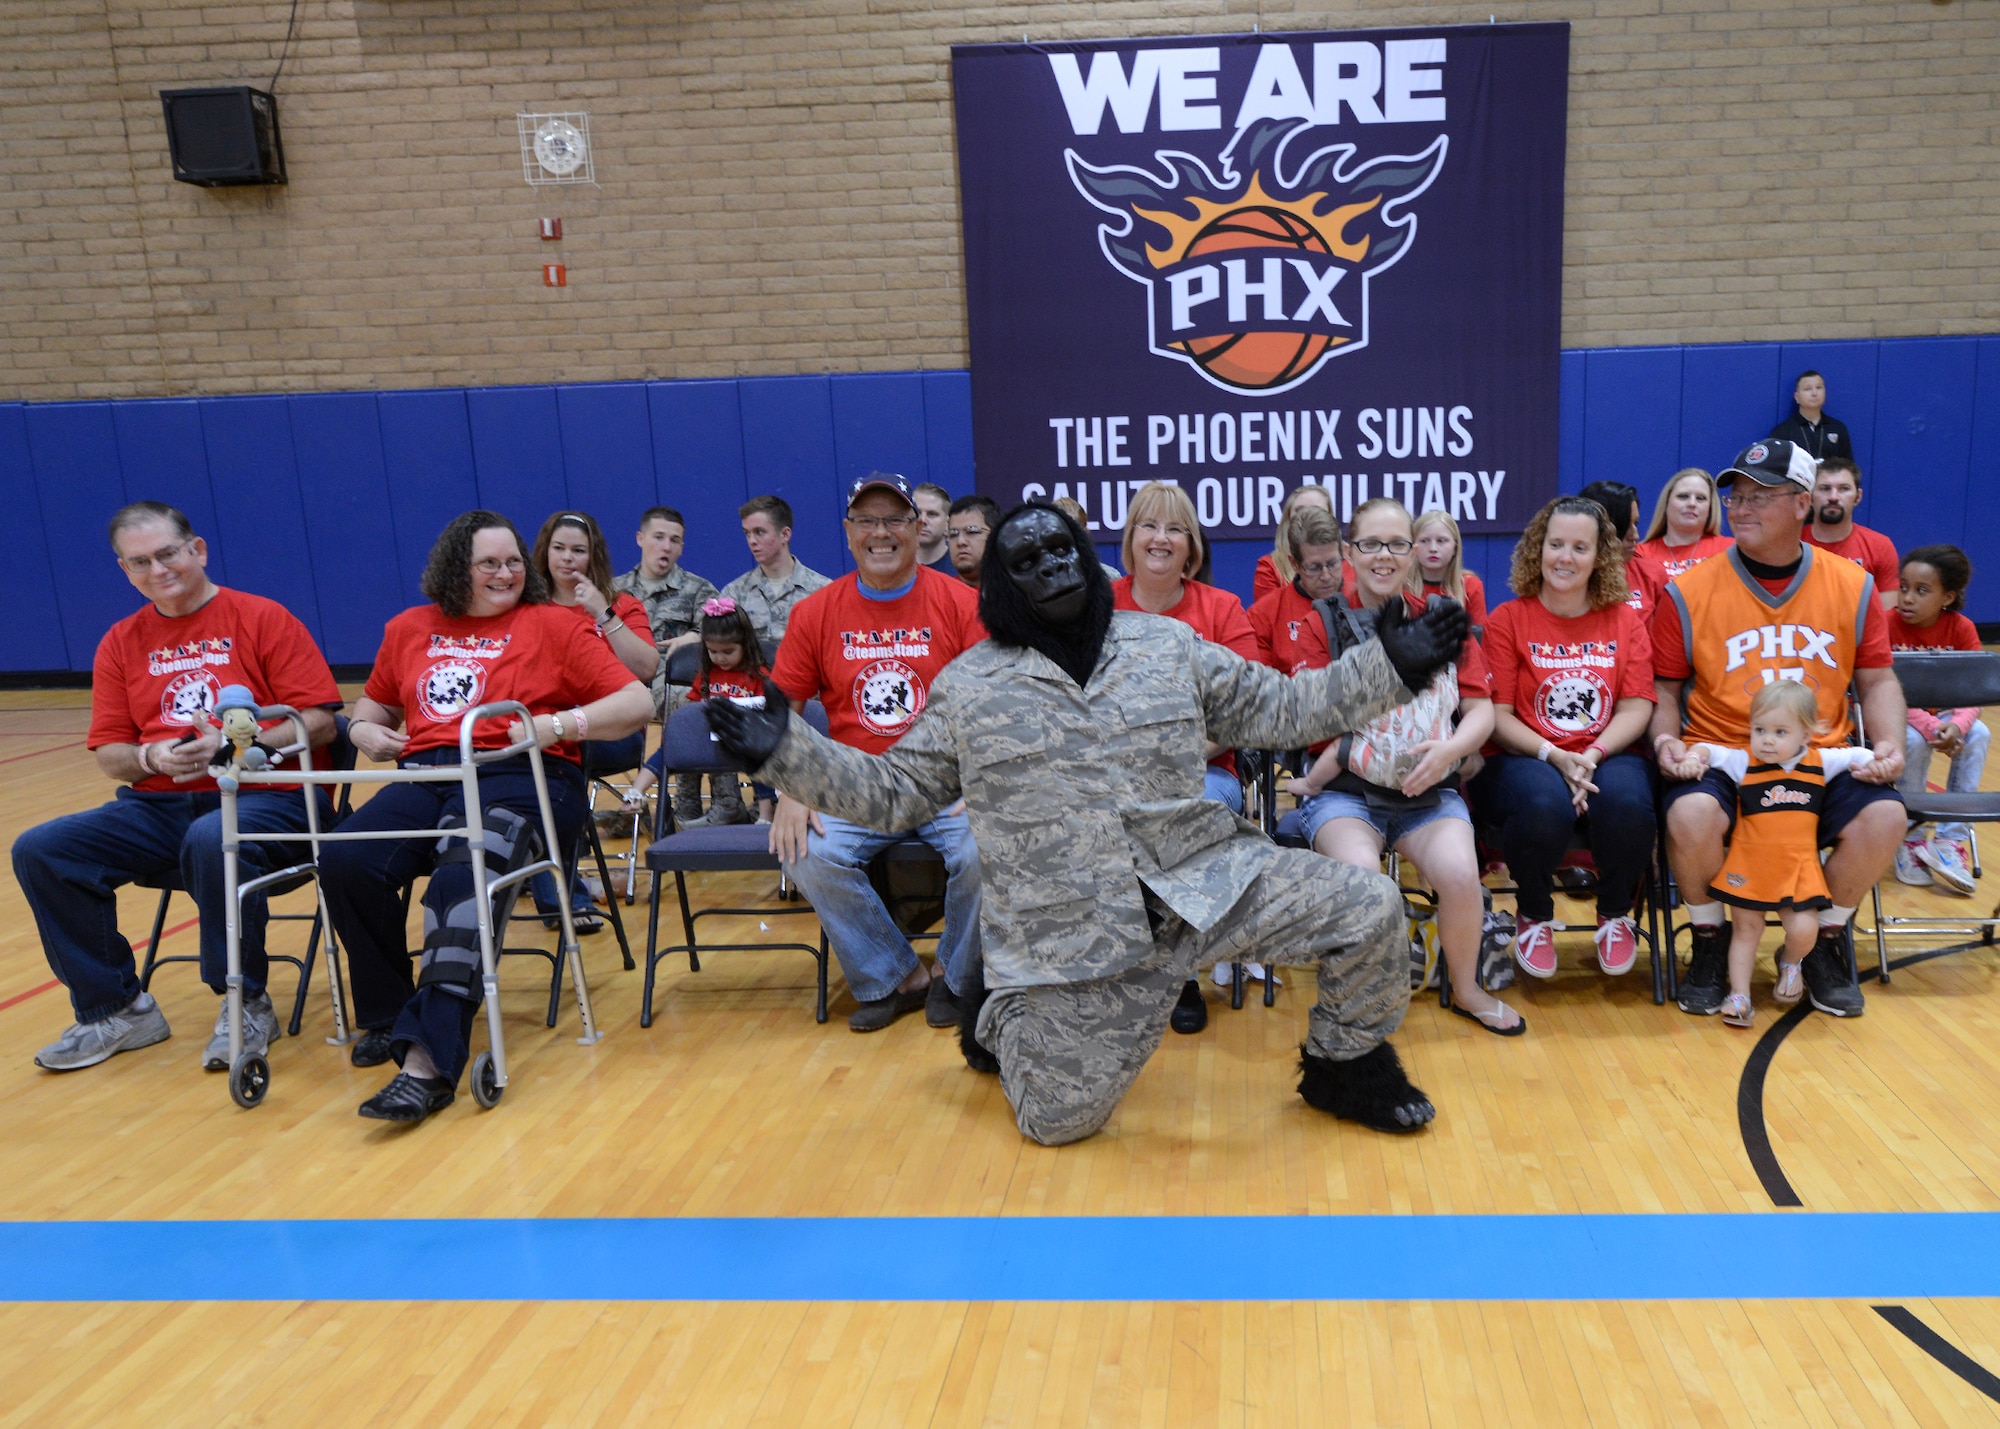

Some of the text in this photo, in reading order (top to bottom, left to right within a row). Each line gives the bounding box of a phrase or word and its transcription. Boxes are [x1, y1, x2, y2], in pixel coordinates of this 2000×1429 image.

[1048, 38, 1446, 135] WE ARE
[1165, 258, 1352, 331] PHX
[1050, 406, 1473, 467] THE PHOENIX SUNS
[1197, 477, 1284, 527] OUR
[843, 643, 929, 660] @teams4taps
[1531, 654, 1615, 669] @teams4taps
[1725, 624, 1838, 672] PHX
